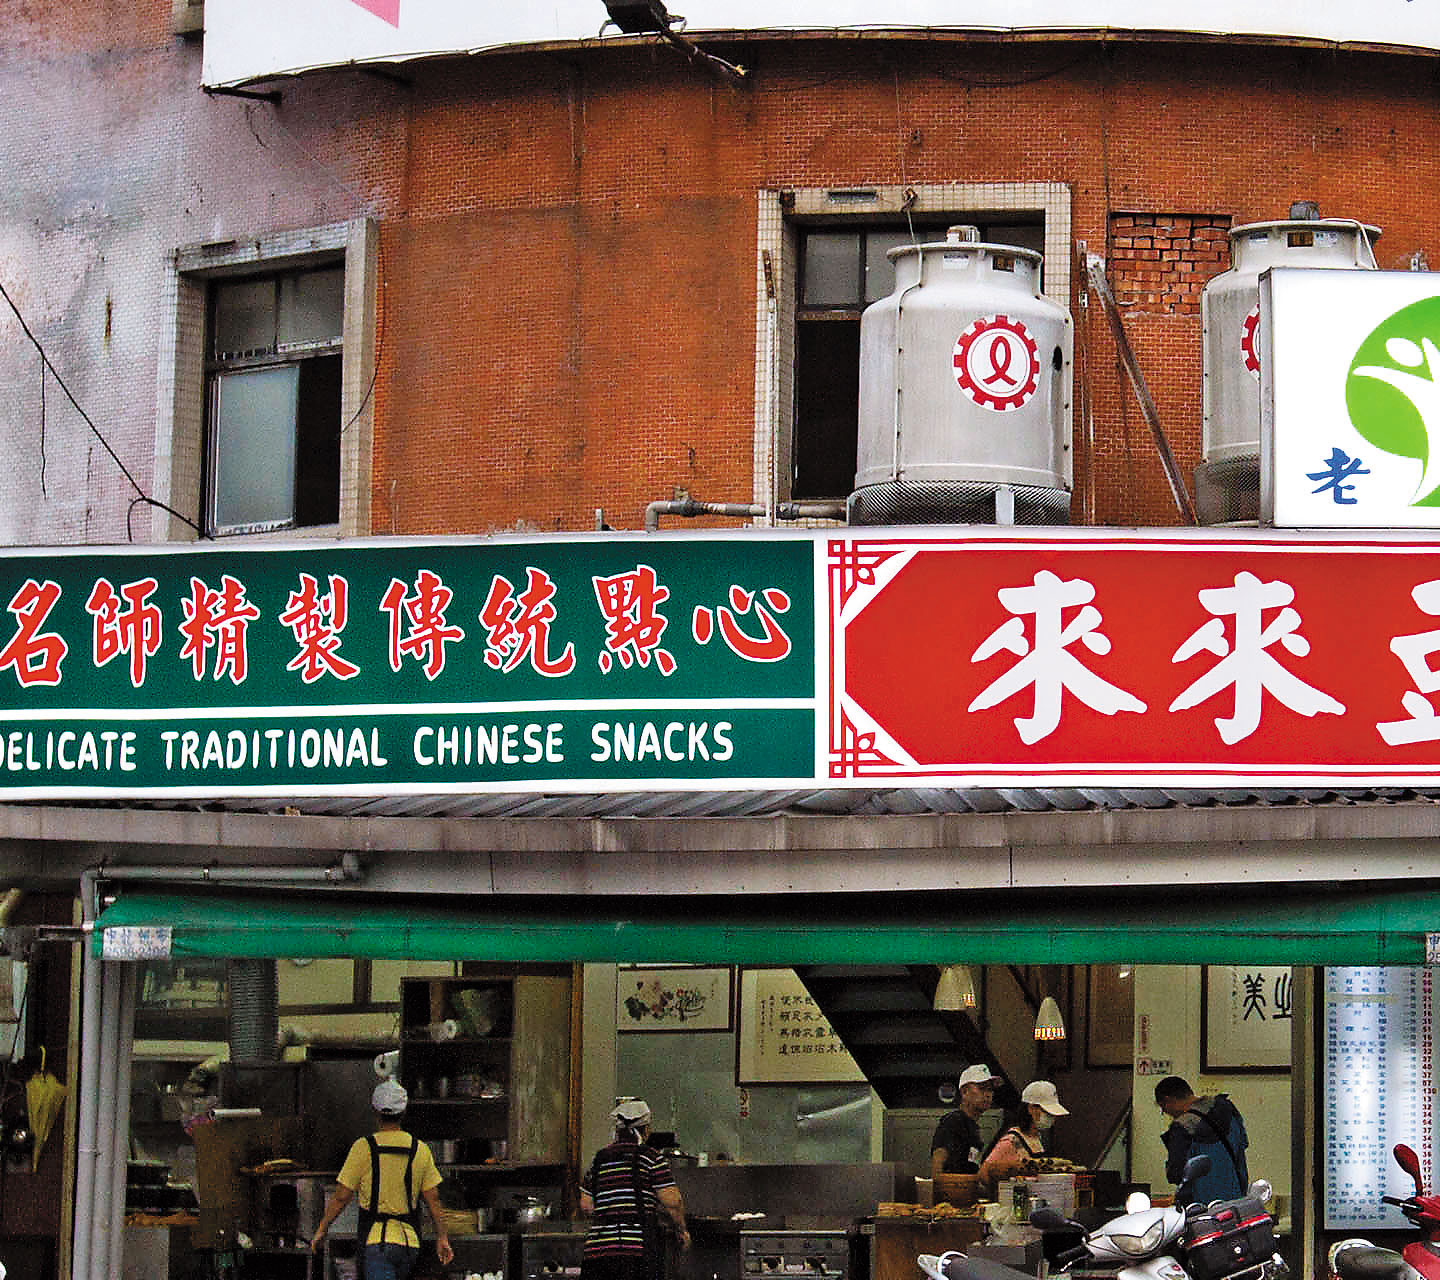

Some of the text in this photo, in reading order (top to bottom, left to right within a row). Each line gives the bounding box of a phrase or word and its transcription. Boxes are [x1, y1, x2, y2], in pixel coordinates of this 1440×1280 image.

[1305, 447, 1371, 505] 老
[160, 726, 388, 769] TRADITIONAL
[414, 723, 564, 767] CHINESE
[591, 720, 734, 762] SNACKS
